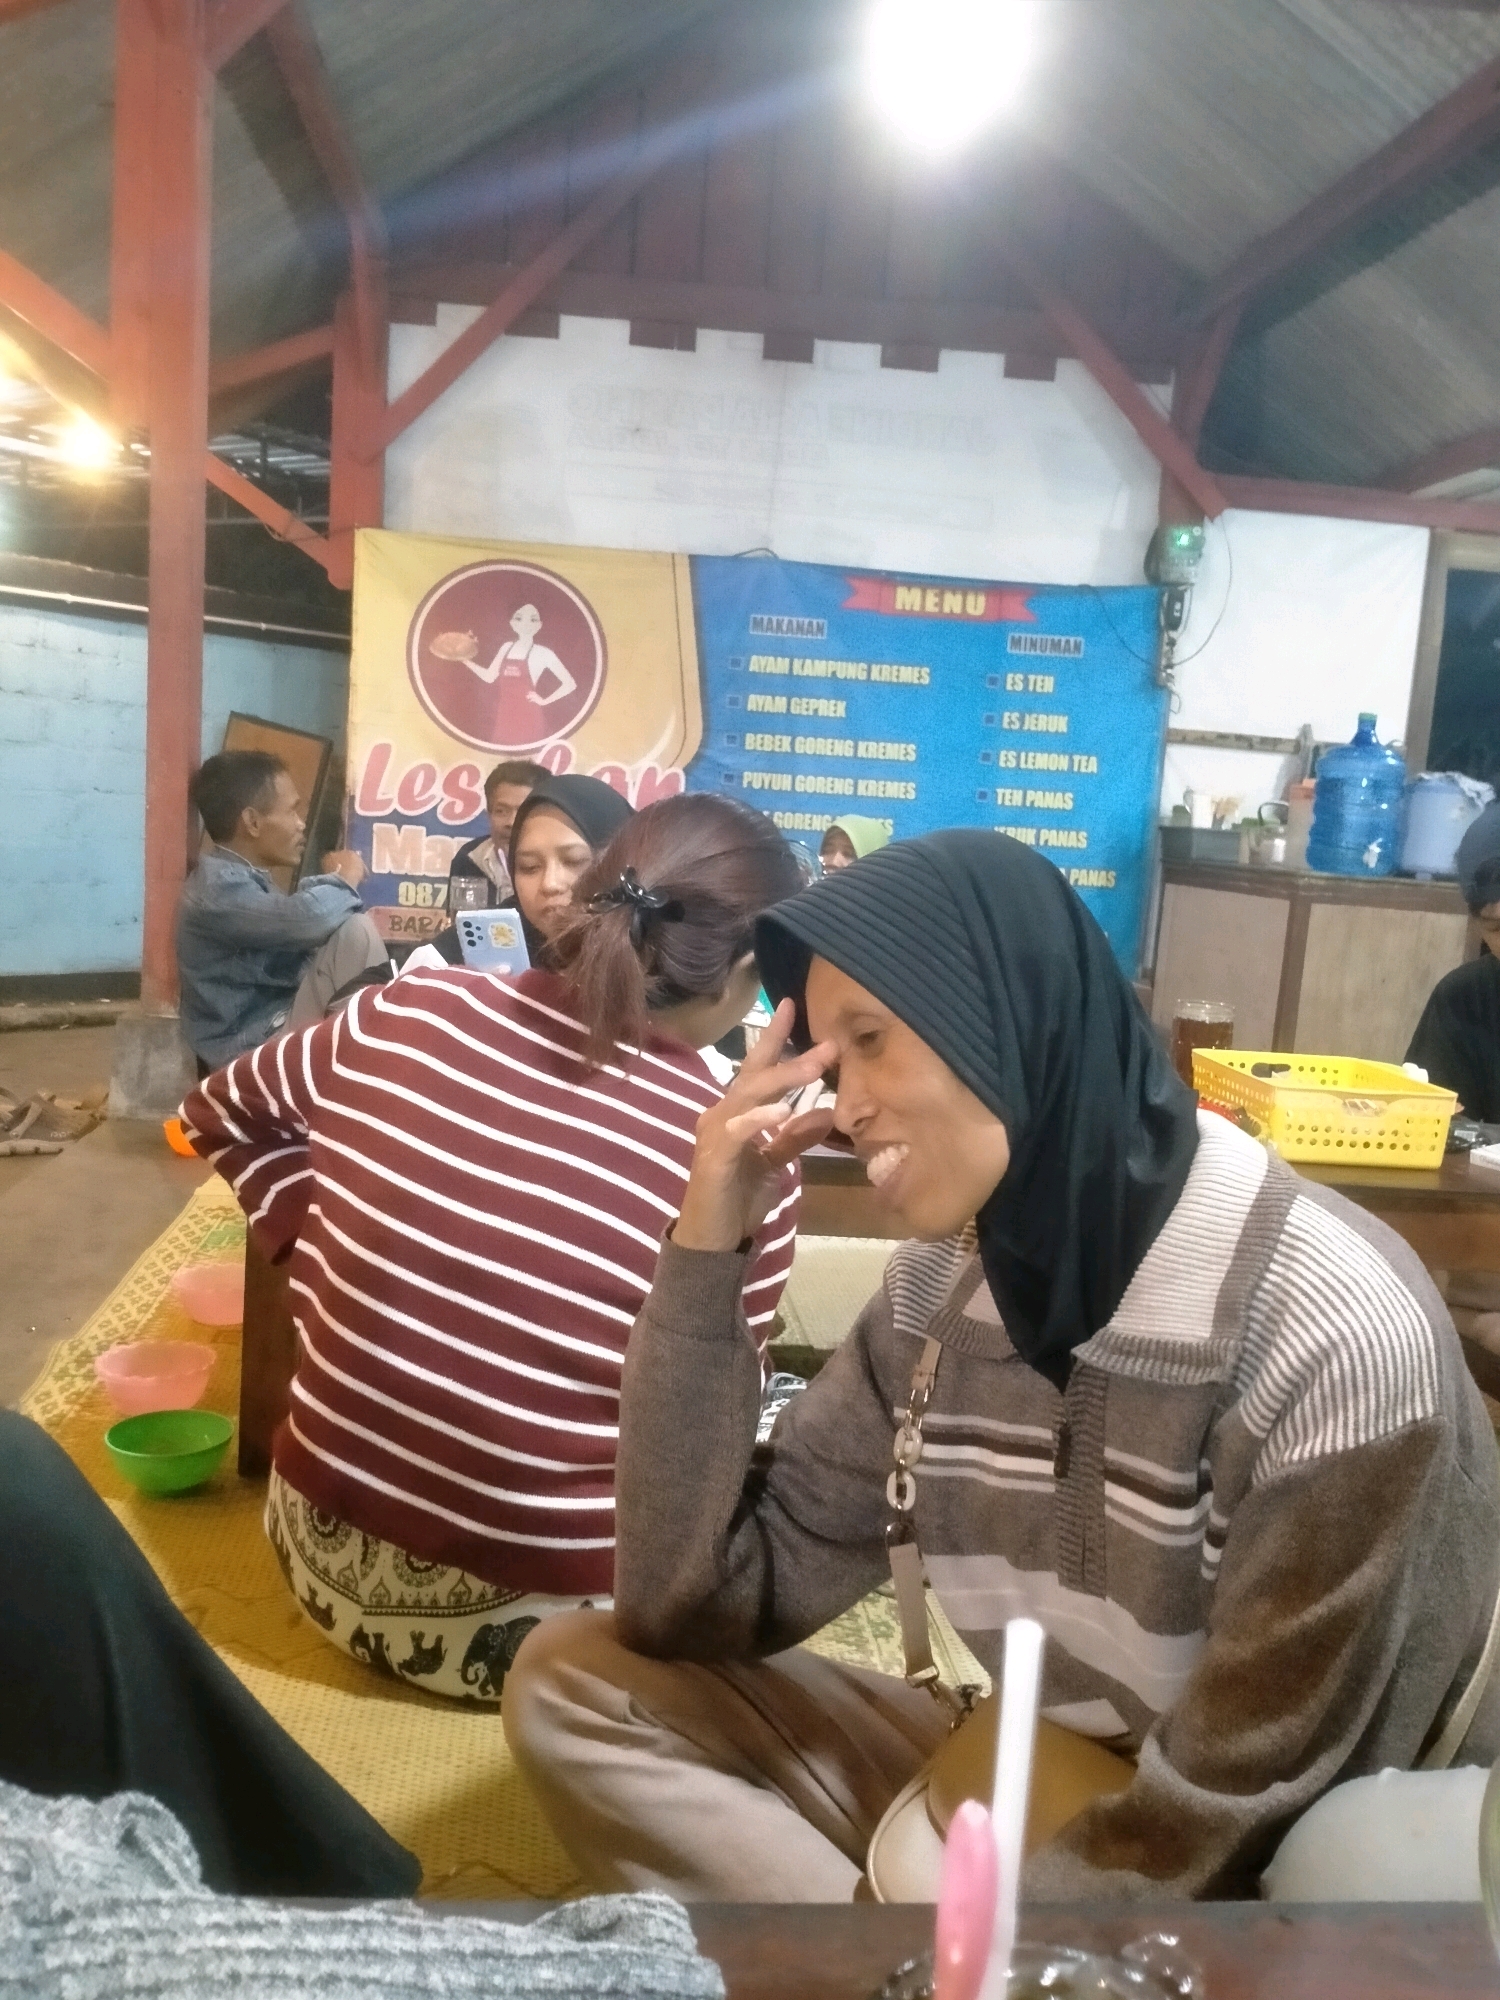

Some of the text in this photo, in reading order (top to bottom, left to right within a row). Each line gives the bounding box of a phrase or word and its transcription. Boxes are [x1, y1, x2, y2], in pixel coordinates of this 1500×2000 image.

[895, 586, 986, 616] MENU
[752, 616, 825, 637] MAKANAN
[1009, 634, 1083, 655] MINUMAN
[749, 655, 930, 684] AYAM KAMPUNG KREMES
[1006, 673, 1054, 693] ES TEH
[747, 694, 846, 717] AYAM GEPREK
[1002, 712, 1068, 733] ES JERUK
[745, 733, 916, 762] BEBEK GORENG KREMES
[999, 750, 1098, 774] ES LEMON TEA
[743, 771, 916, 800] PUYUH GORENG KREMES
[996, 788, 1073, 810] TEH PANAS
[773, 811, 832, 832] GORENG
[1039, 828, 1088, 849] PANAS
[1069, 868, 1116, 888] PANAS
[398, 881, 449, 907] 087
